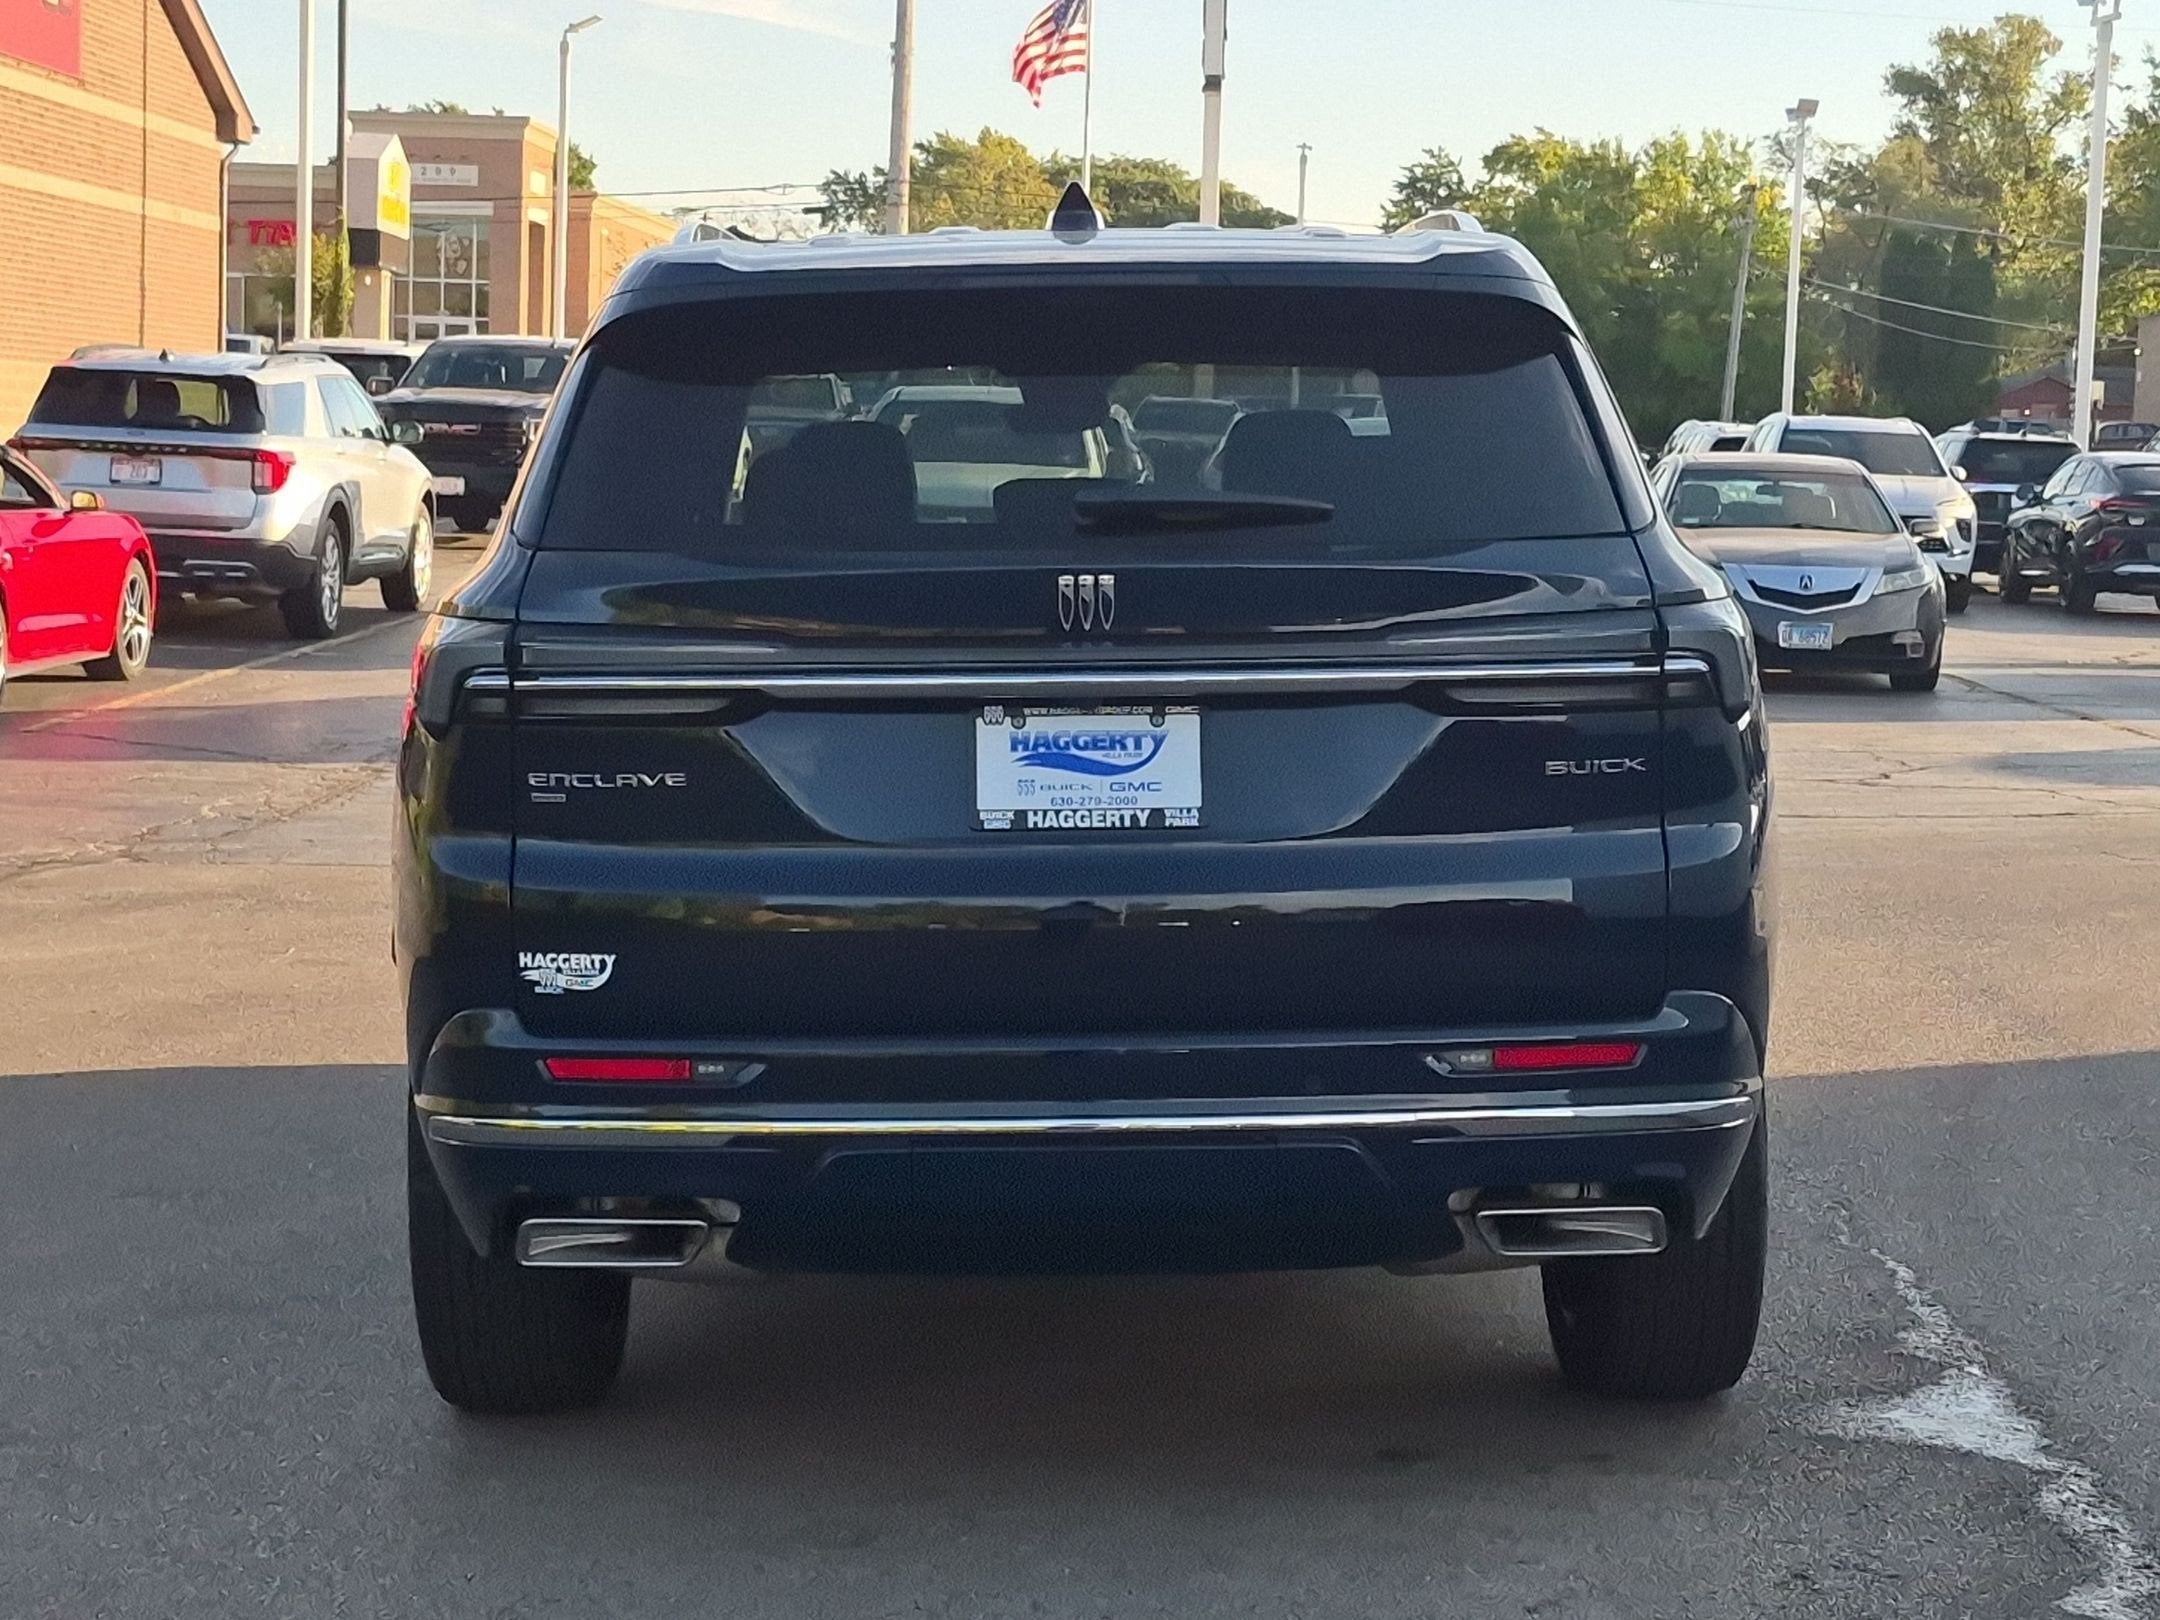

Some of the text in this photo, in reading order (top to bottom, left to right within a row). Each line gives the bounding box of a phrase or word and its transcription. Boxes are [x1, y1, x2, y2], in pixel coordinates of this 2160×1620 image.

[1165, 705, 1200, 713] GMC
[1009, 730, 1169, 753] HAGGERTY
[1545, 758, 1647, 775] BUICK
[528, 772, 687, 788] ENCLAVE
[1040, 781, 1162, 792] BUICK GMC
[1050, 796, 1138, 807] 630-279-2000
[980, 810, 1014, 820] BUICK
[1027, 809, 1151, 828] HAGGERTY
[1164, 808, 1199, 818] VILLA
[518, 951, 616, 969] HAGGERTY
